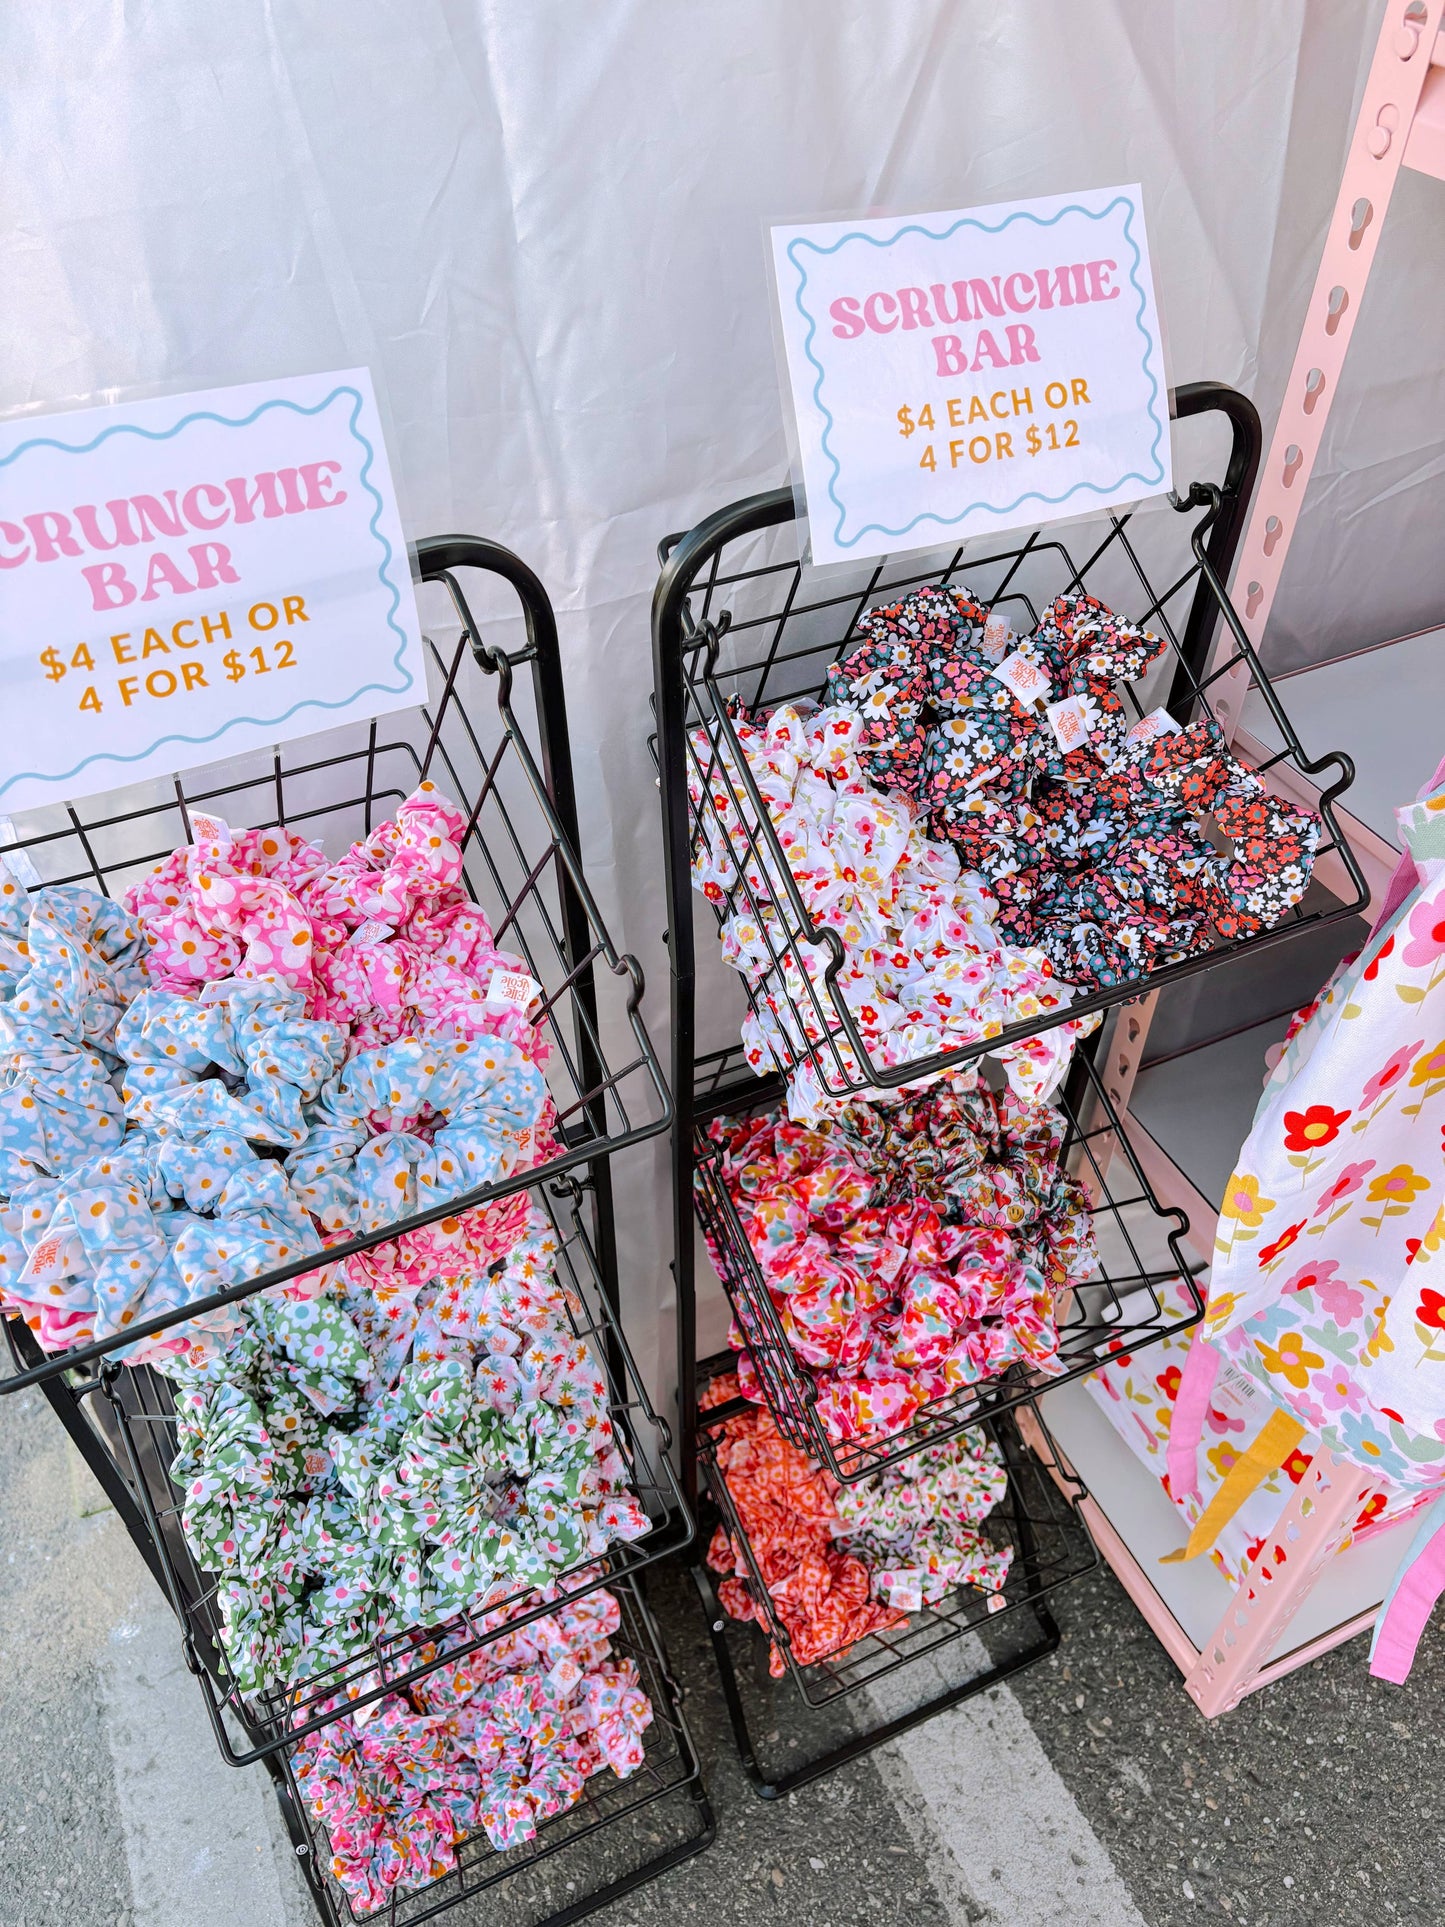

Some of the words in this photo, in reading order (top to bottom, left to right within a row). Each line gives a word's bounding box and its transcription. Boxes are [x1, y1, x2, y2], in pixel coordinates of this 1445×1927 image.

[829, 259, 1121, 340] SCRUNCHIE
[931, 323, 1041, 378] BAR
[897, 403, 935, 438] $4
[946, 387, 1034, 427] EACH
[1044, 377, 1091, 410] OR
[919, 445, 937, 473] 4
[948, 431, 1015, 468] FOR
[1026, 419, 1081, 457] $12
[81, 541, 241, 612] BAR
[39, 642, 95, 684] $4
[110, 611, 233, 665] EACH
[247, 595, 310, 632] OR
[992, 624, 1005, 655] Nicole
[78, 685, 103, 714] 4
[117, 661, 210, 707] FOR
[222, 640, 298, 684] $12
[1012, 670, 1029, 689] Elle
[1014, 659, 1038, 687] Nicole
[1057, 711, 1073, 743] Nicole
[1067, 711, 1080, 734] Elle
[504, 987, 527, 1002] Elle
